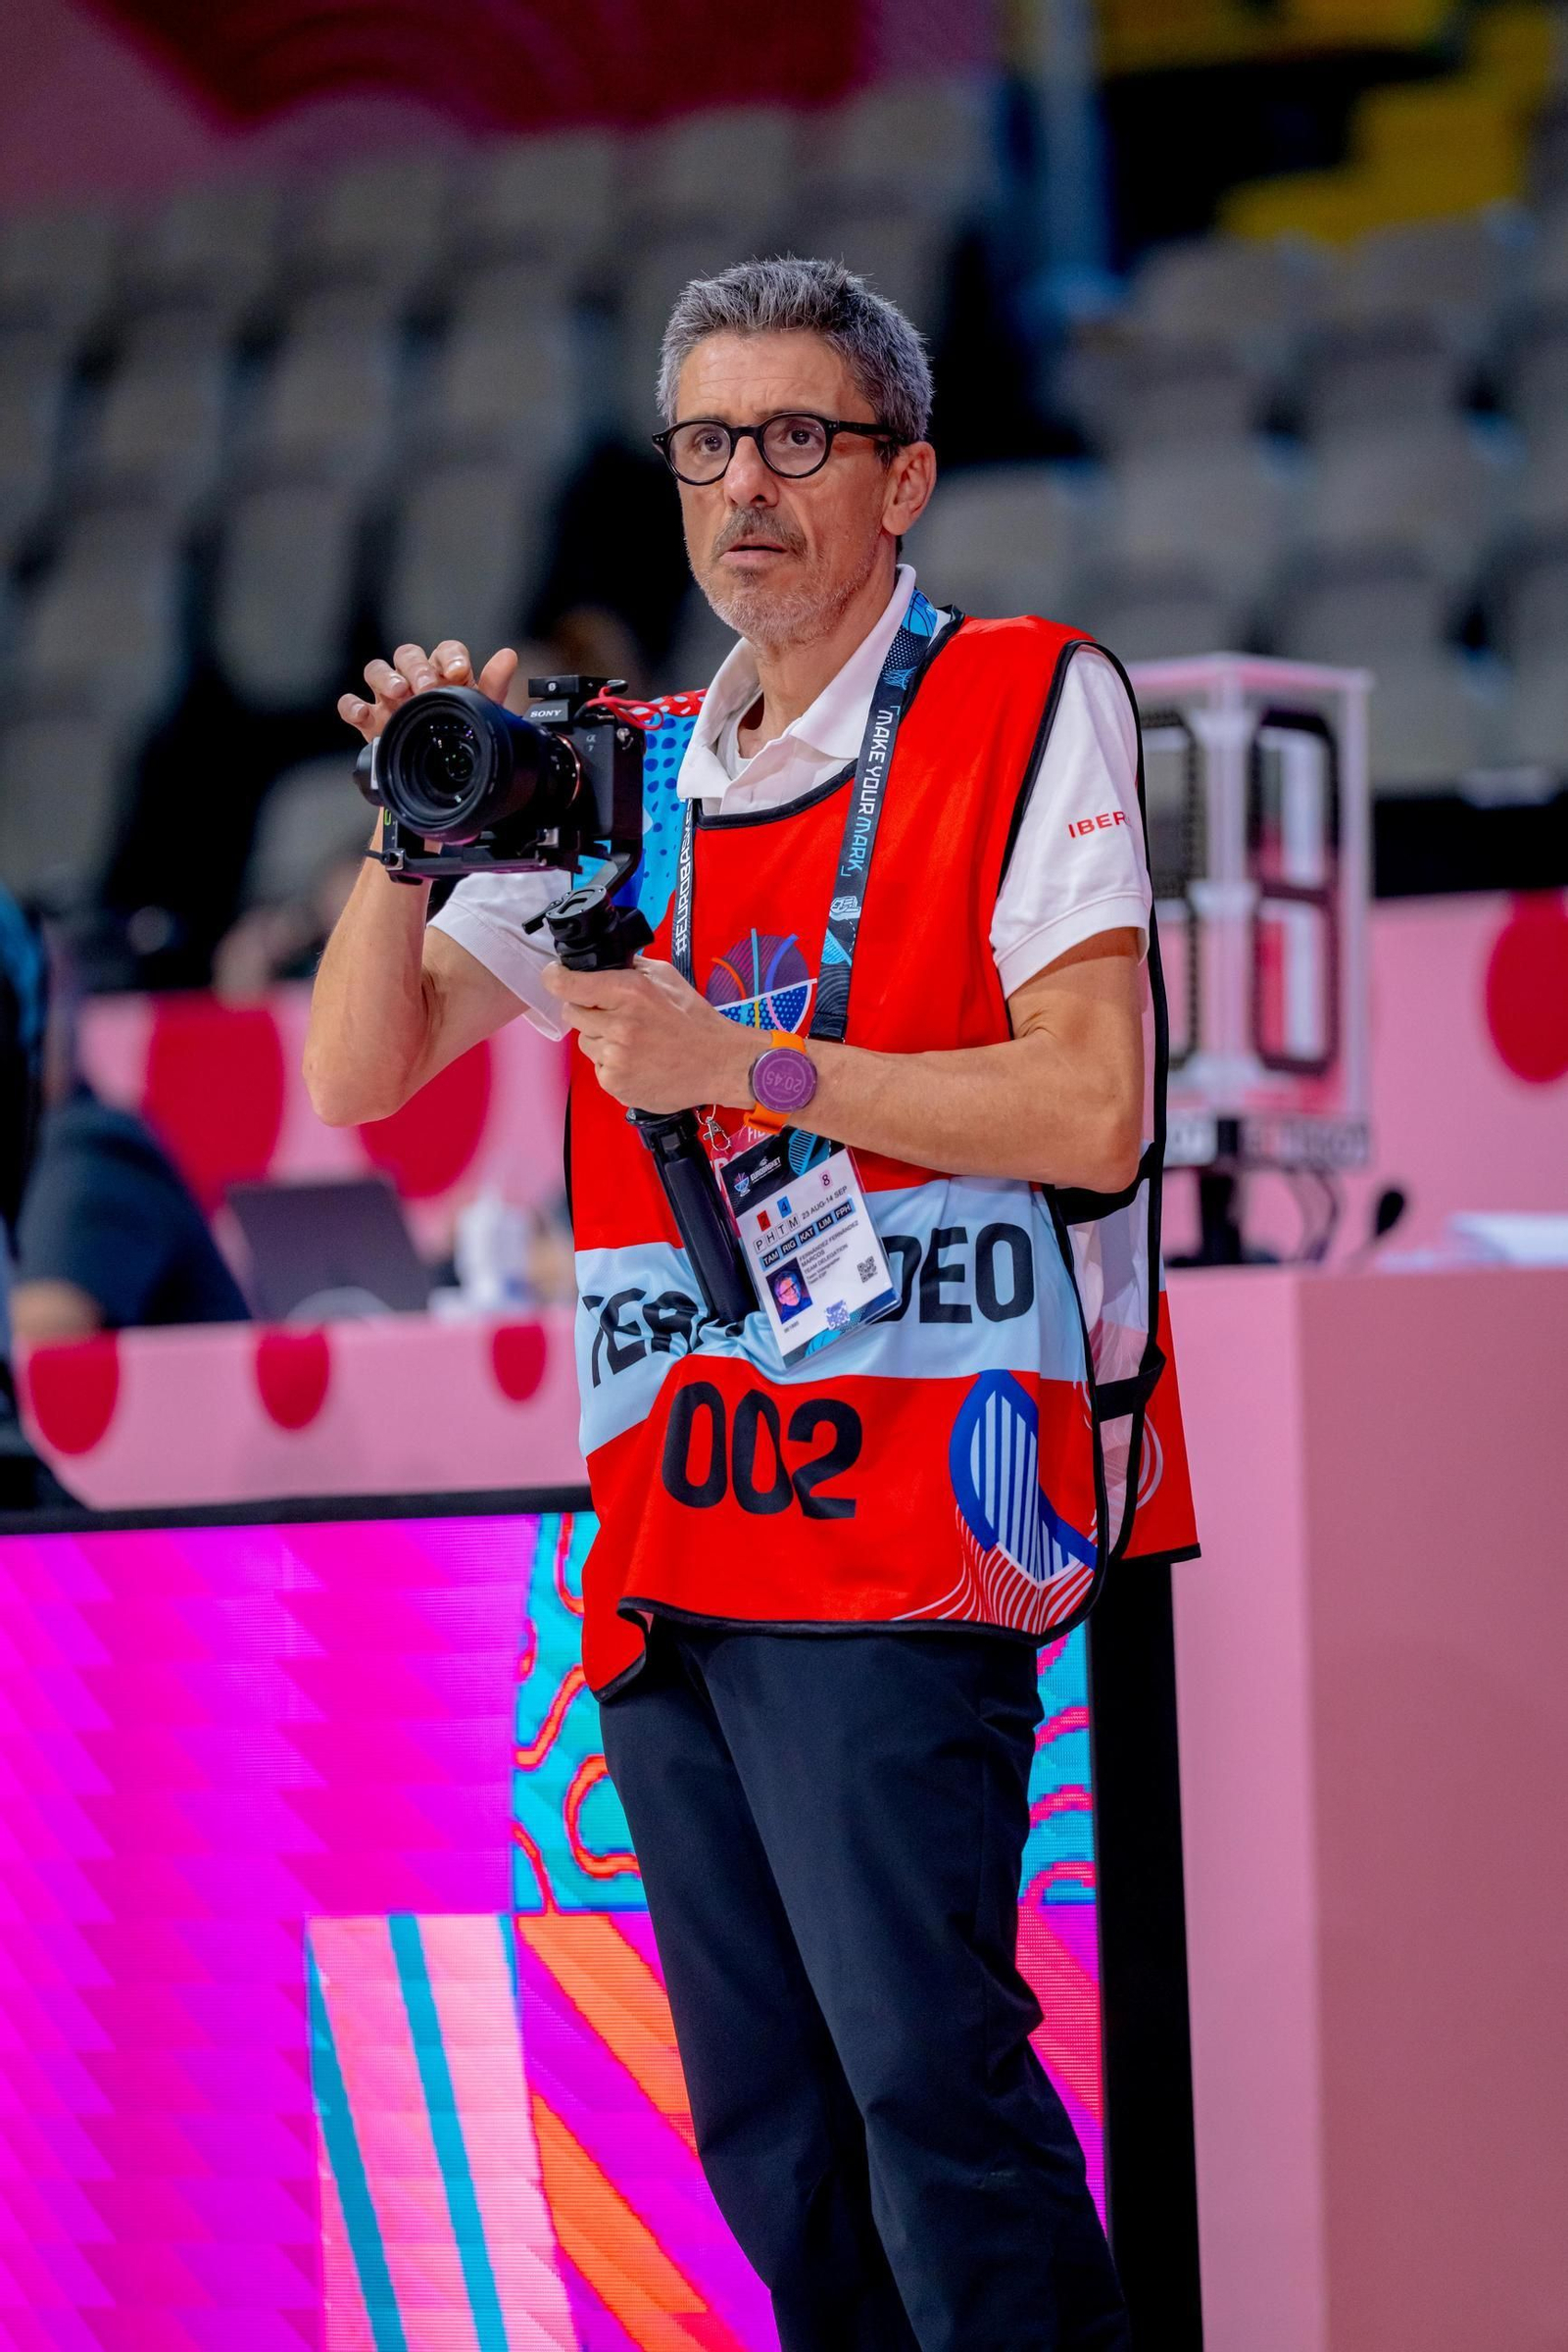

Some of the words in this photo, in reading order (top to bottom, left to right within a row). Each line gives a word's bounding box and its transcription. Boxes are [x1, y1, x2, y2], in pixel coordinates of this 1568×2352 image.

[530, 710, 562, 718] SONY
[868, 710, 893, 763] MAKE
[858, 764, 883, 814] YOUR
[847, 816, 871, 871] MARK
[822, 1174, 831, 1186] 8
[801, 1210, 810, 1220] 23
[833, 1185, 848, 1199] SEP
[755, 1240, 764, 1250] P
[766, 1234, 775, 1245] H
[777, 1224, 785, 1235] T
[788, 1217, 799, 1229] M
[762, 1250, 779, 1266] TAM
[781, 1240, 797, 1253] RIG
[799, 1227, 814, 1242] KAT
[817, 1216, 833, 1230] LIM
[835, 1203, 852, 1219] FPH
[801, 1250, 825, 1267] MARCOS
[662, 1381, 862, 1519] 002
